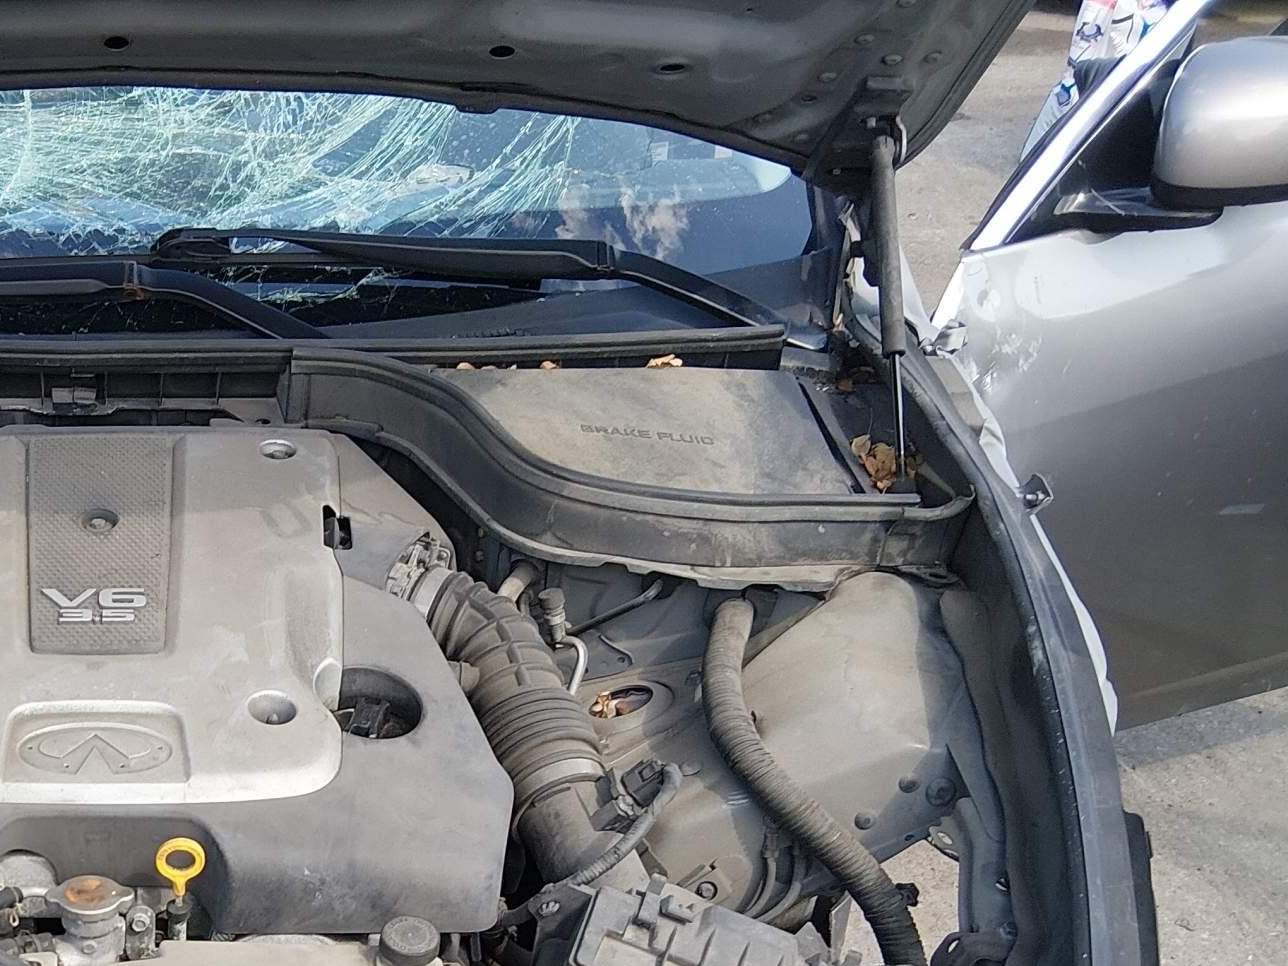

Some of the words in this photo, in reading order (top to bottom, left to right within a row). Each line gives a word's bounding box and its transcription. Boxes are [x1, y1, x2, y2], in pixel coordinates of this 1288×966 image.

[580, 423, 652, 438] BRAKE
[655, 431, 715, 445] FLUID
[40, 588, 147, 608] V6
[57, 608, 136, 623] 3.5
